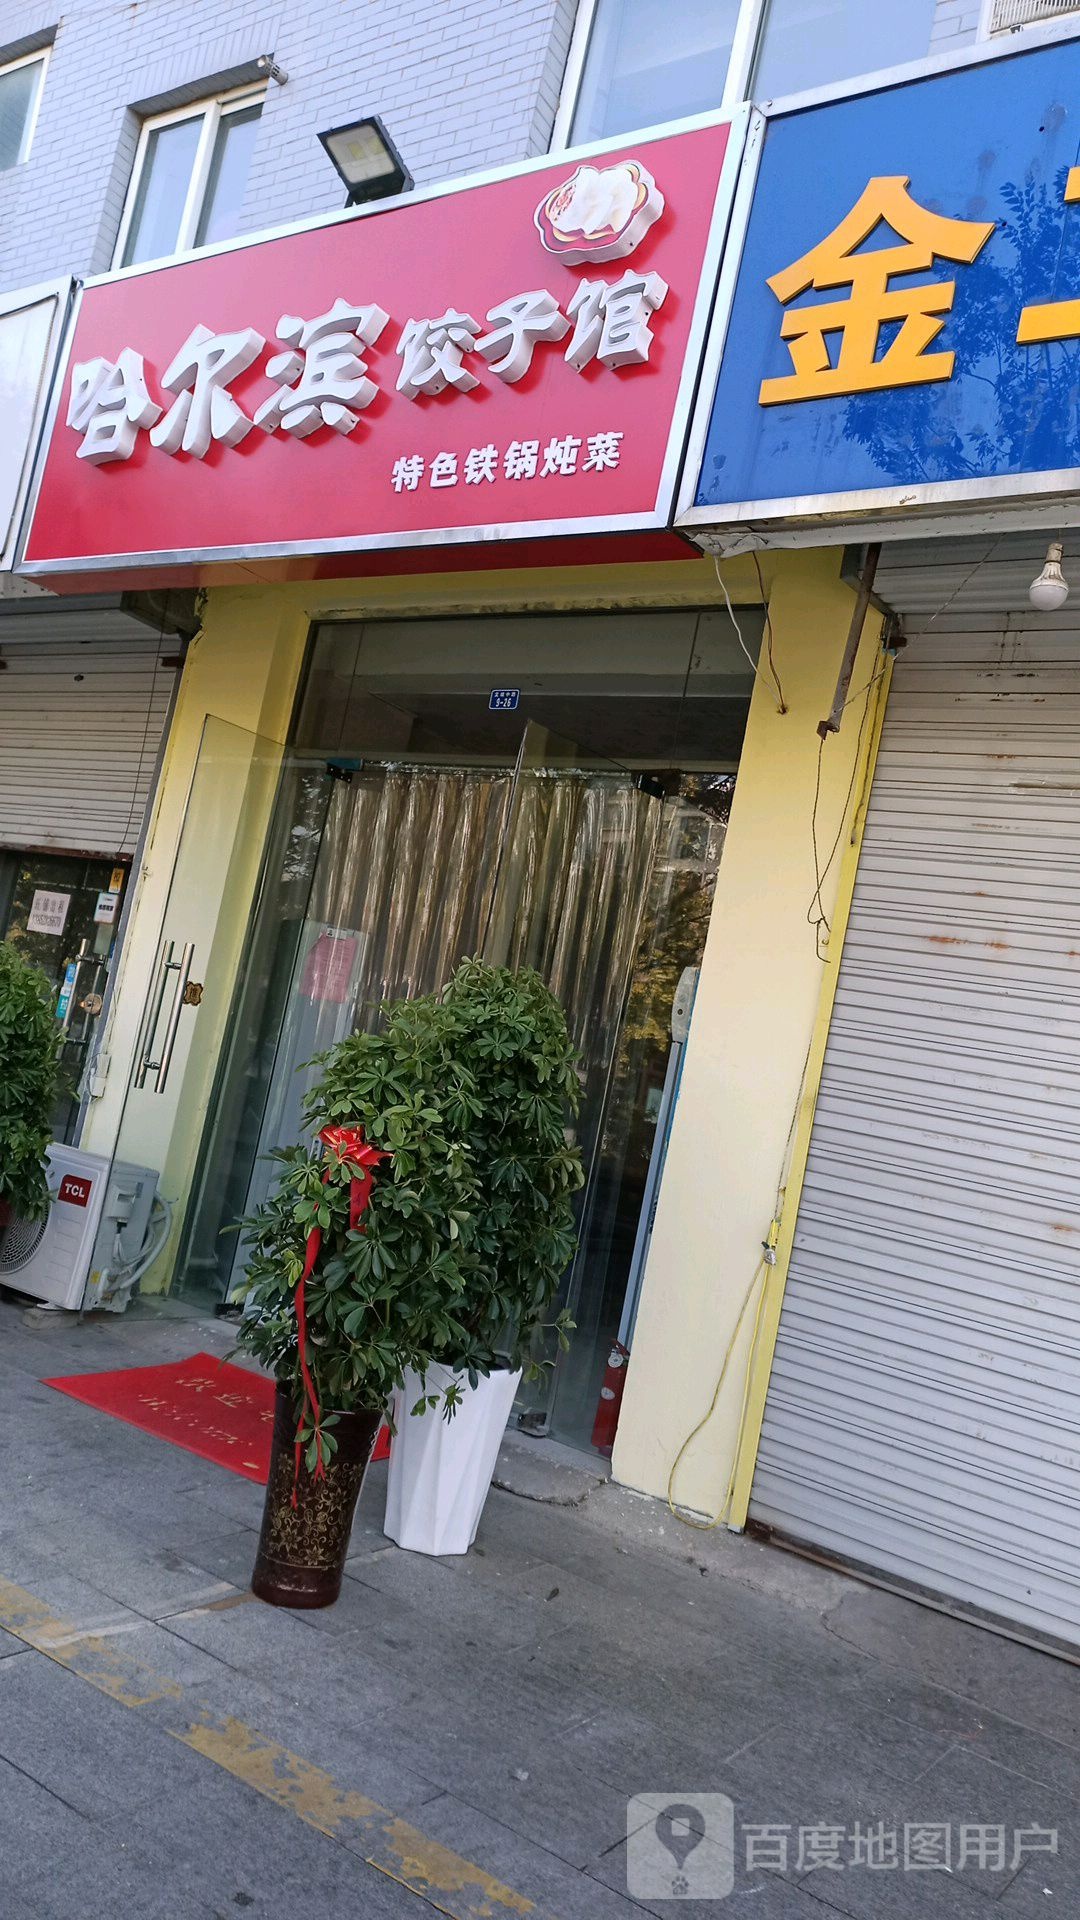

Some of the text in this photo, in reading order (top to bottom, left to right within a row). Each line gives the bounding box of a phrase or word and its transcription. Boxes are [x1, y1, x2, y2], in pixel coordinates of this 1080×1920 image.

[65, 269, 669, 464] 哈尔滨饺子馆
[391, 431, 624, 494] 特色铁锅炖菜
[65, 1183, 85, 1198] TCL
